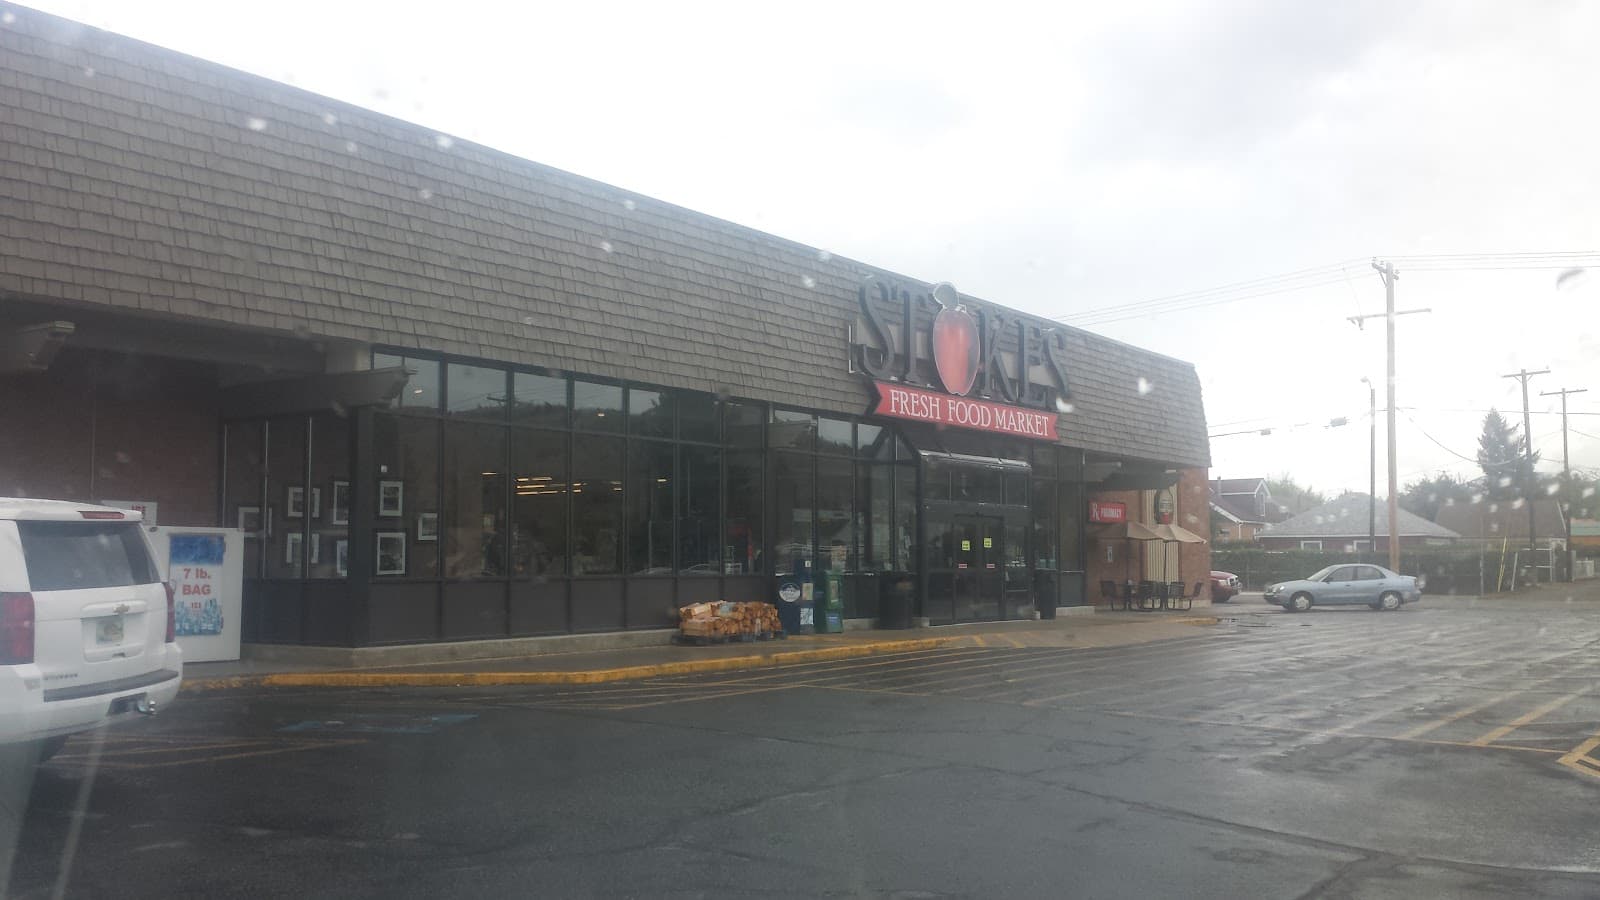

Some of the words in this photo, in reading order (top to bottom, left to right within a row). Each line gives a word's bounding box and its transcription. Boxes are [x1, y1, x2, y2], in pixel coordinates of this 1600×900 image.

[889, 389, 942, 420] FRESH
[947, 399, 991, 428] FOOD
[994, 407, 1049, 437] MARKET
[183, 568, 191, 579] 7
[182, 584, 212, 595] BAG
